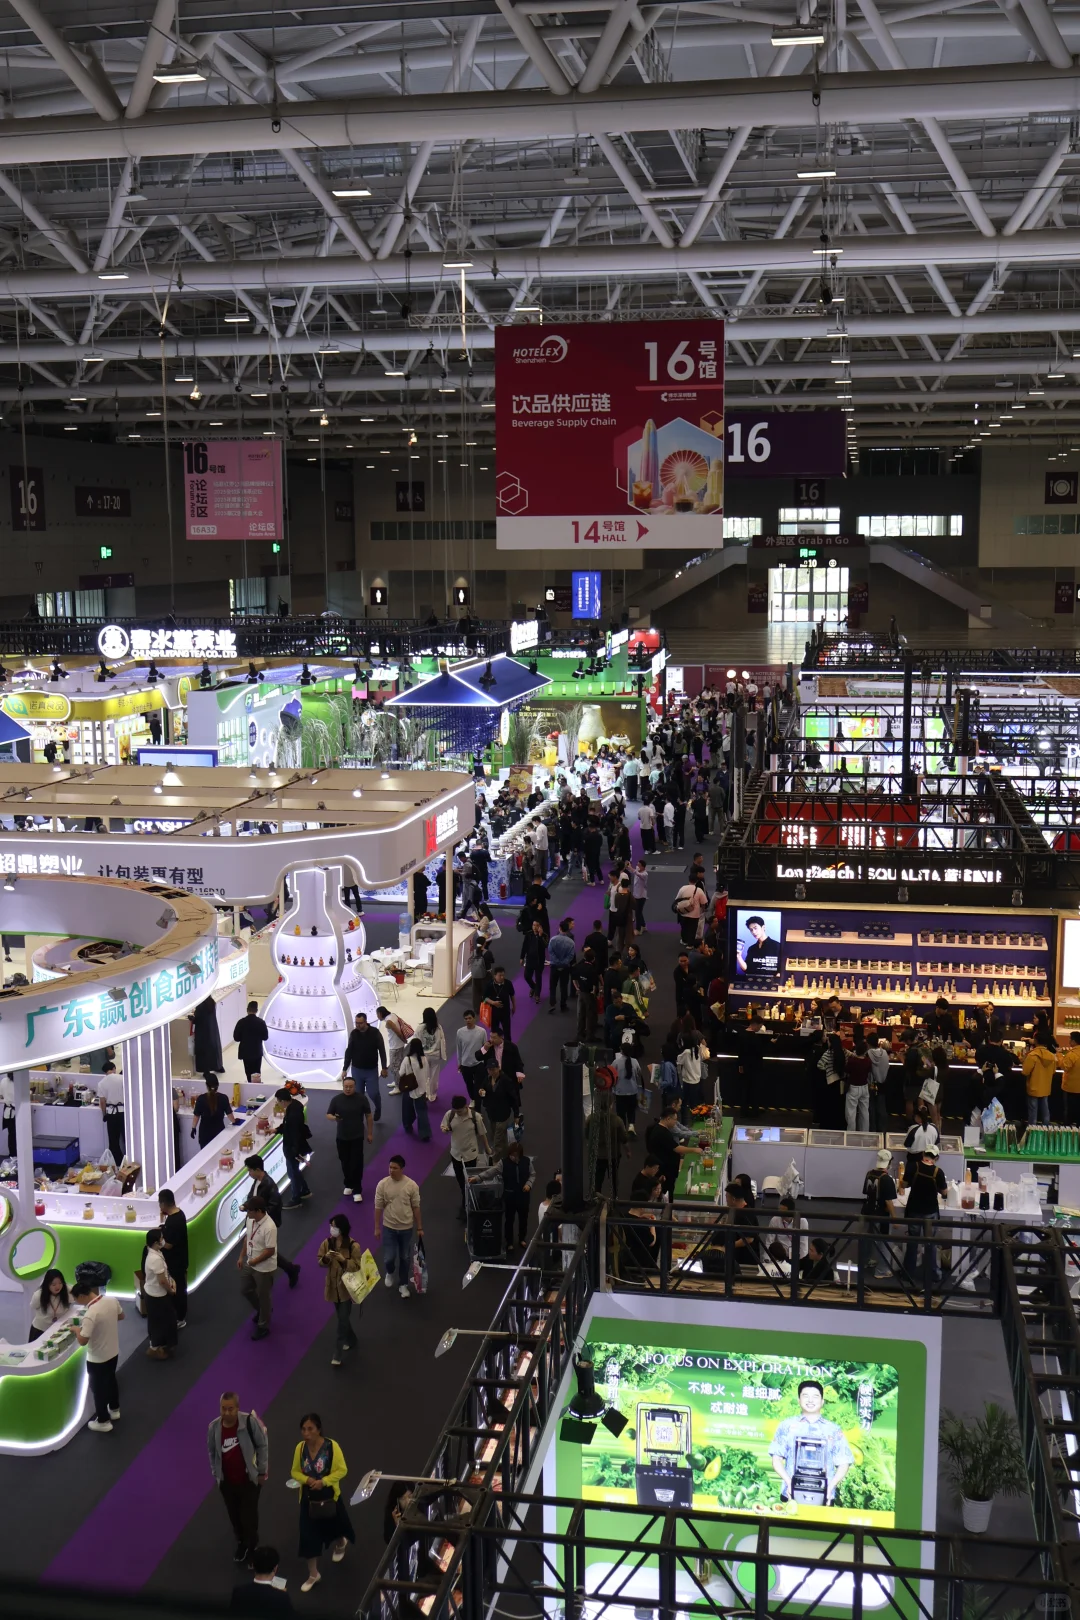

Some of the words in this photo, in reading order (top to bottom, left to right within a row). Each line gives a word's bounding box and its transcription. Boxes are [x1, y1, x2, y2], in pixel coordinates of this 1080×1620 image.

[512, 344, 560, 358] HOTELEX
[644, 341, 695, 382] 16
[512, 393, 611, 414] 饮品供应链
[512, 418, 555, 428] Beverage
[556, 417, 589, 427] Supply
[591, 416, 617, 426] Chain
[728, 421, 771, 463] 16
[185, 442, 208, 474] 16
[18, 479, 37, 515] 16
[196, 479, 208, 518] 论坛区
[800, 483, 820, 501] 16
[103, 495, 121, 511] 17-20
[192, 526, 217, 534] 16A32
[249, 522, 276, 532] 论坛区
[572, 520, 600, 543] 14
[603, 520, 625, 532] 号馆
[602, 534, 627, 542] HALL
[765, 536, 796, 546] 外卖区
[798, 535, 824, 545] Grab
[826, 537, 832, 545] n
[834, 535, 849, 545] Go
[646, 1352, 694, 1371] FOCUS
[697, 1359, 720, 1373] ON
[724, 1361, 832, 1382] EXPLORATION
[224, 1437, 238, 1447] NIKE
